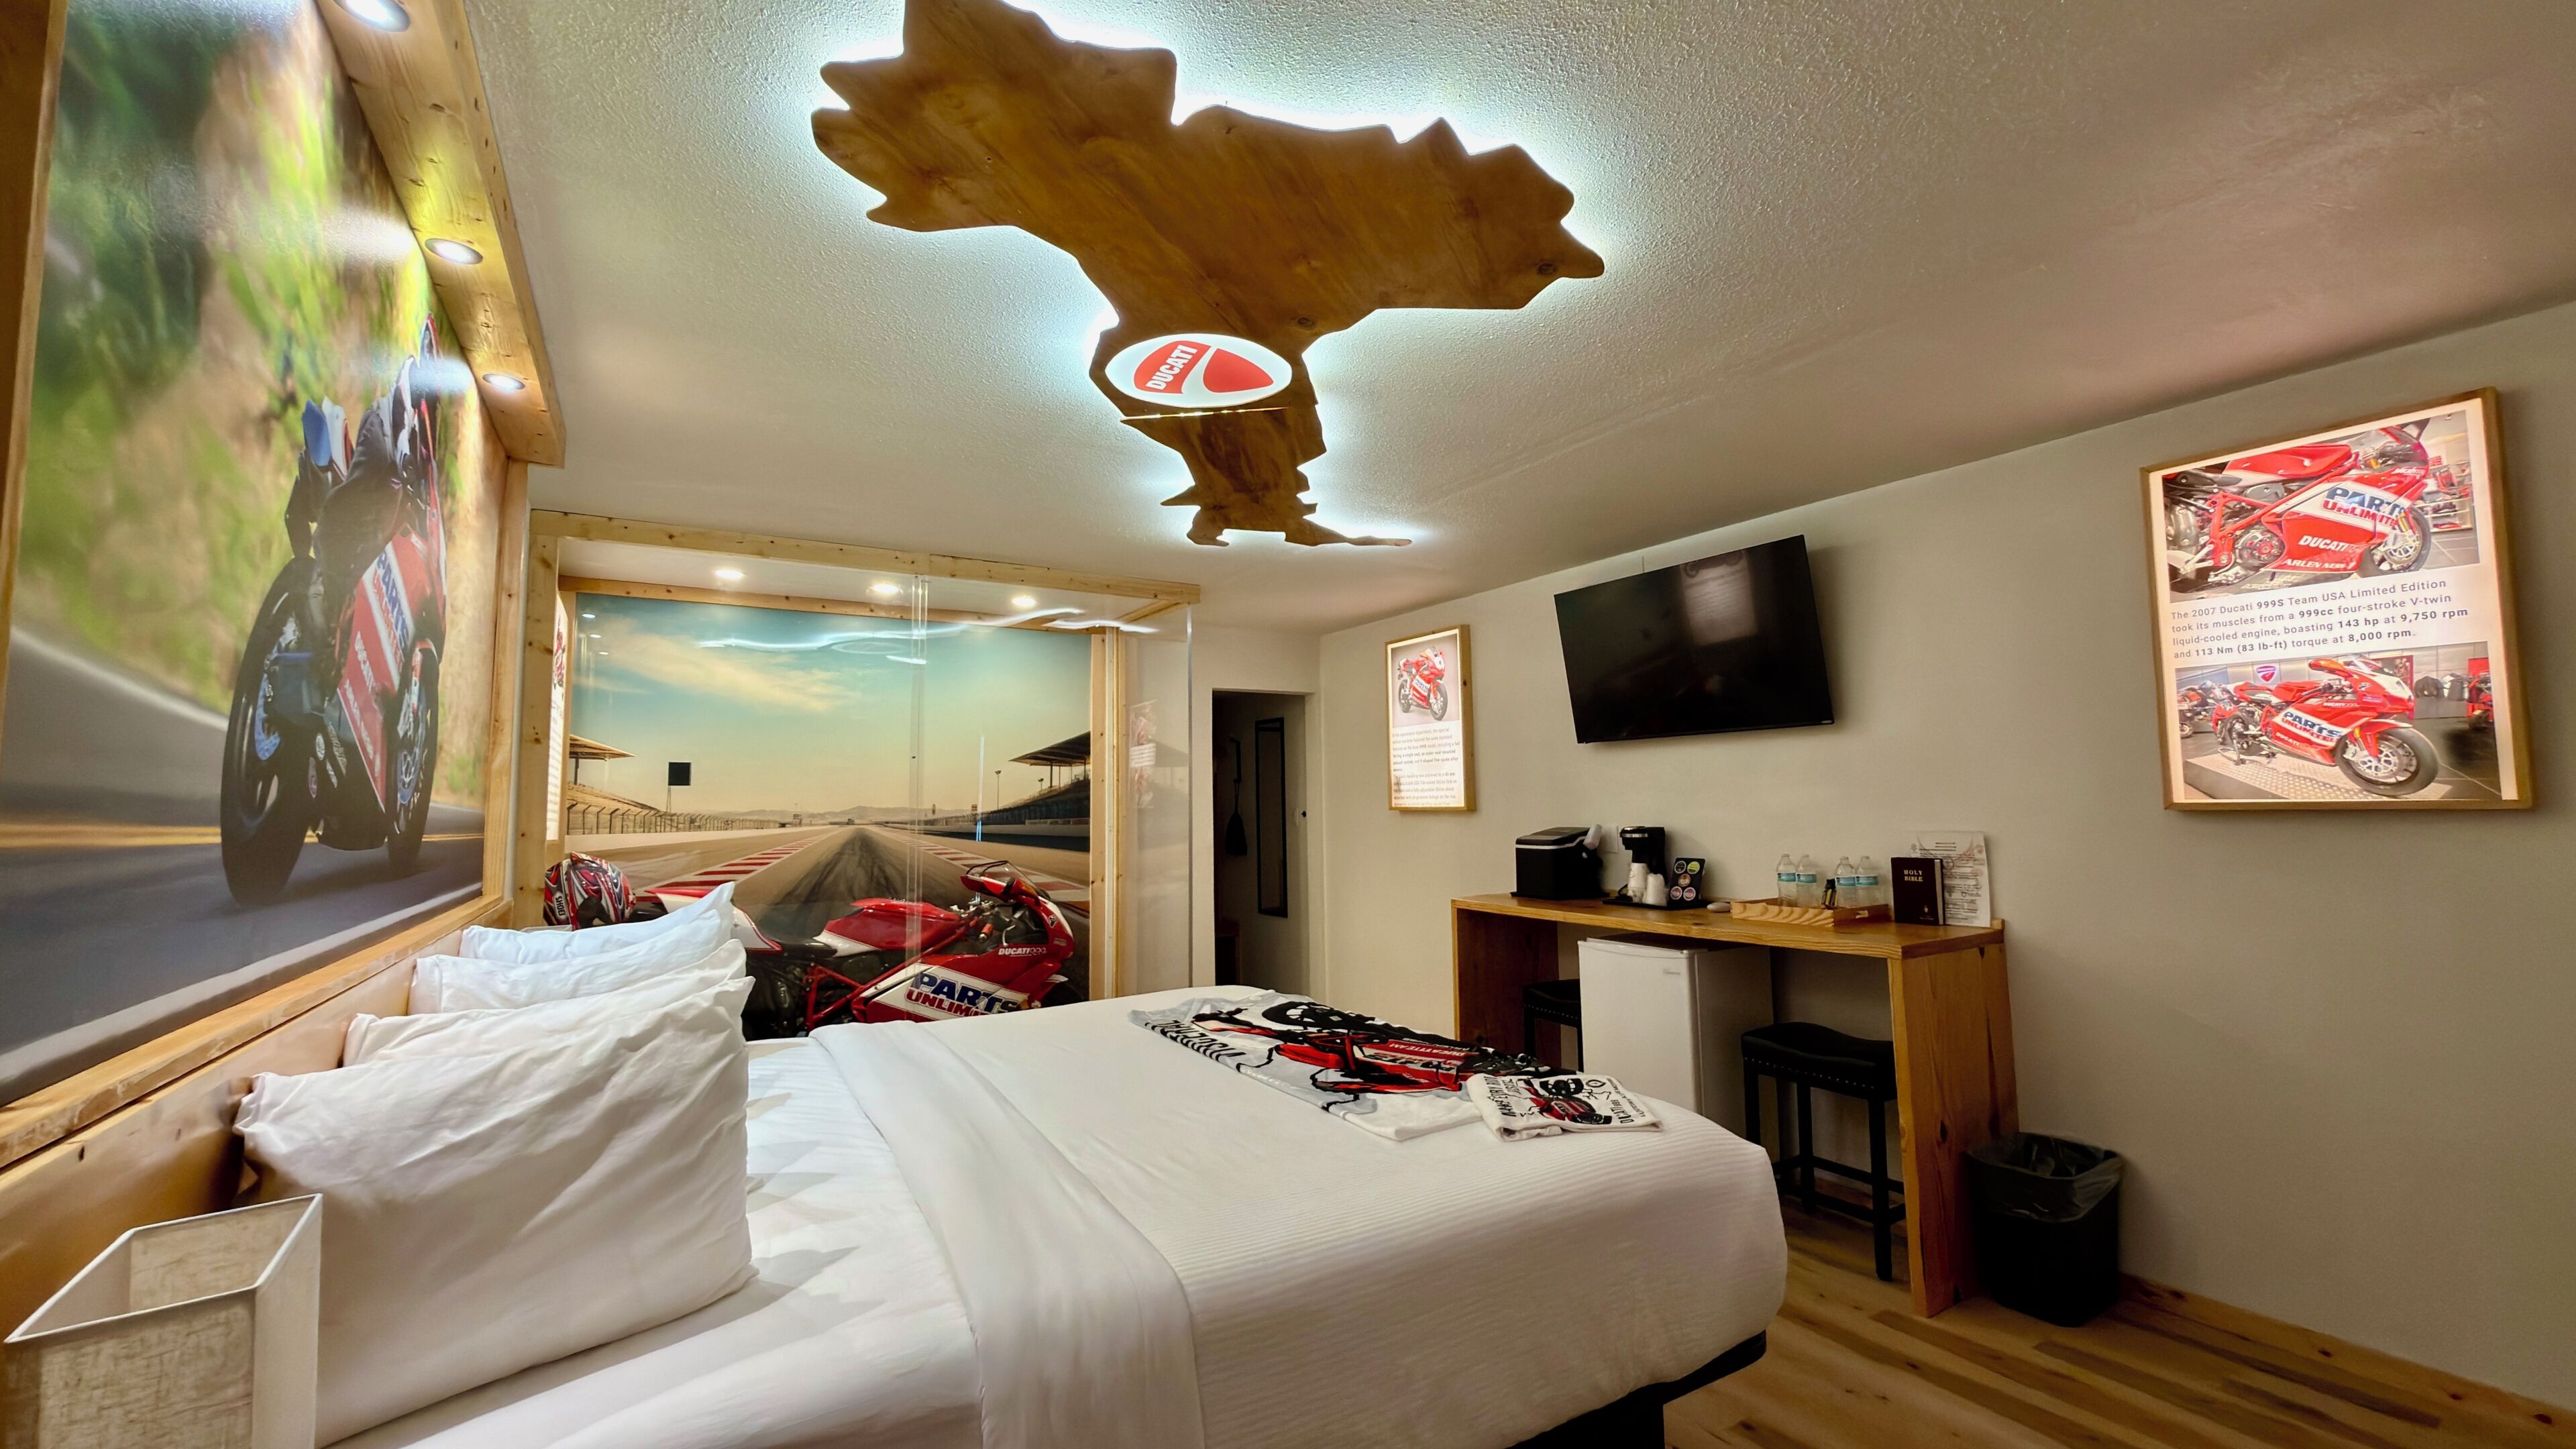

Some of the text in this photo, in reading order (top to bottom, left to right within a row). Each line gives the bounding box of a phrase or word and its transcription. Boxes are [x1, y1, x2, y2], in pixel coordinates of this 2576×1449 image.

[1145, 345, 1198, 390] DUCATI
[2322, 500, 2398, 526] UNLIMITE
[2325, 487, 2405, 516] PARTS
[2298, 535, 2349, 551] DUCATI
[2171, 580, 2447, 620] The 2007 Ducati 999S Team USA Limited Edition
[2171, 623, 2193, 633] took
[2196, 621, 2209, 630] its
[2213, 616, 2255, 628] muscles
[2259, 614, 2284, 623] from
[2299, 608, 2333, 618] 999cc
[2338, 599, 2406, 614] four-stroke
[2410, 594, 2451, 606] V-twin
[2173, 608, 2468, 647] liquid-cooled engine, boasting 143 hp at 9,750 rpm
[2174, 649, 2191, 659] and
[2195, 647, 2212, 657] 113
[2217, 646, 2233, 655] Nm
[2237, 643, 2254, 654] (83
[2259, 639, 2288, 651] lb-ft)
[2292, 637, 2328, 648] torque
[2349, 631, 2382, 643] 8,000
[2387, 629, 2416, 639] rpm.
[2284, 712, 2342, 737] PARTS
[555, 896, 566, 916] SHOEI
[910, 973, 1021, 1014] PARTS
